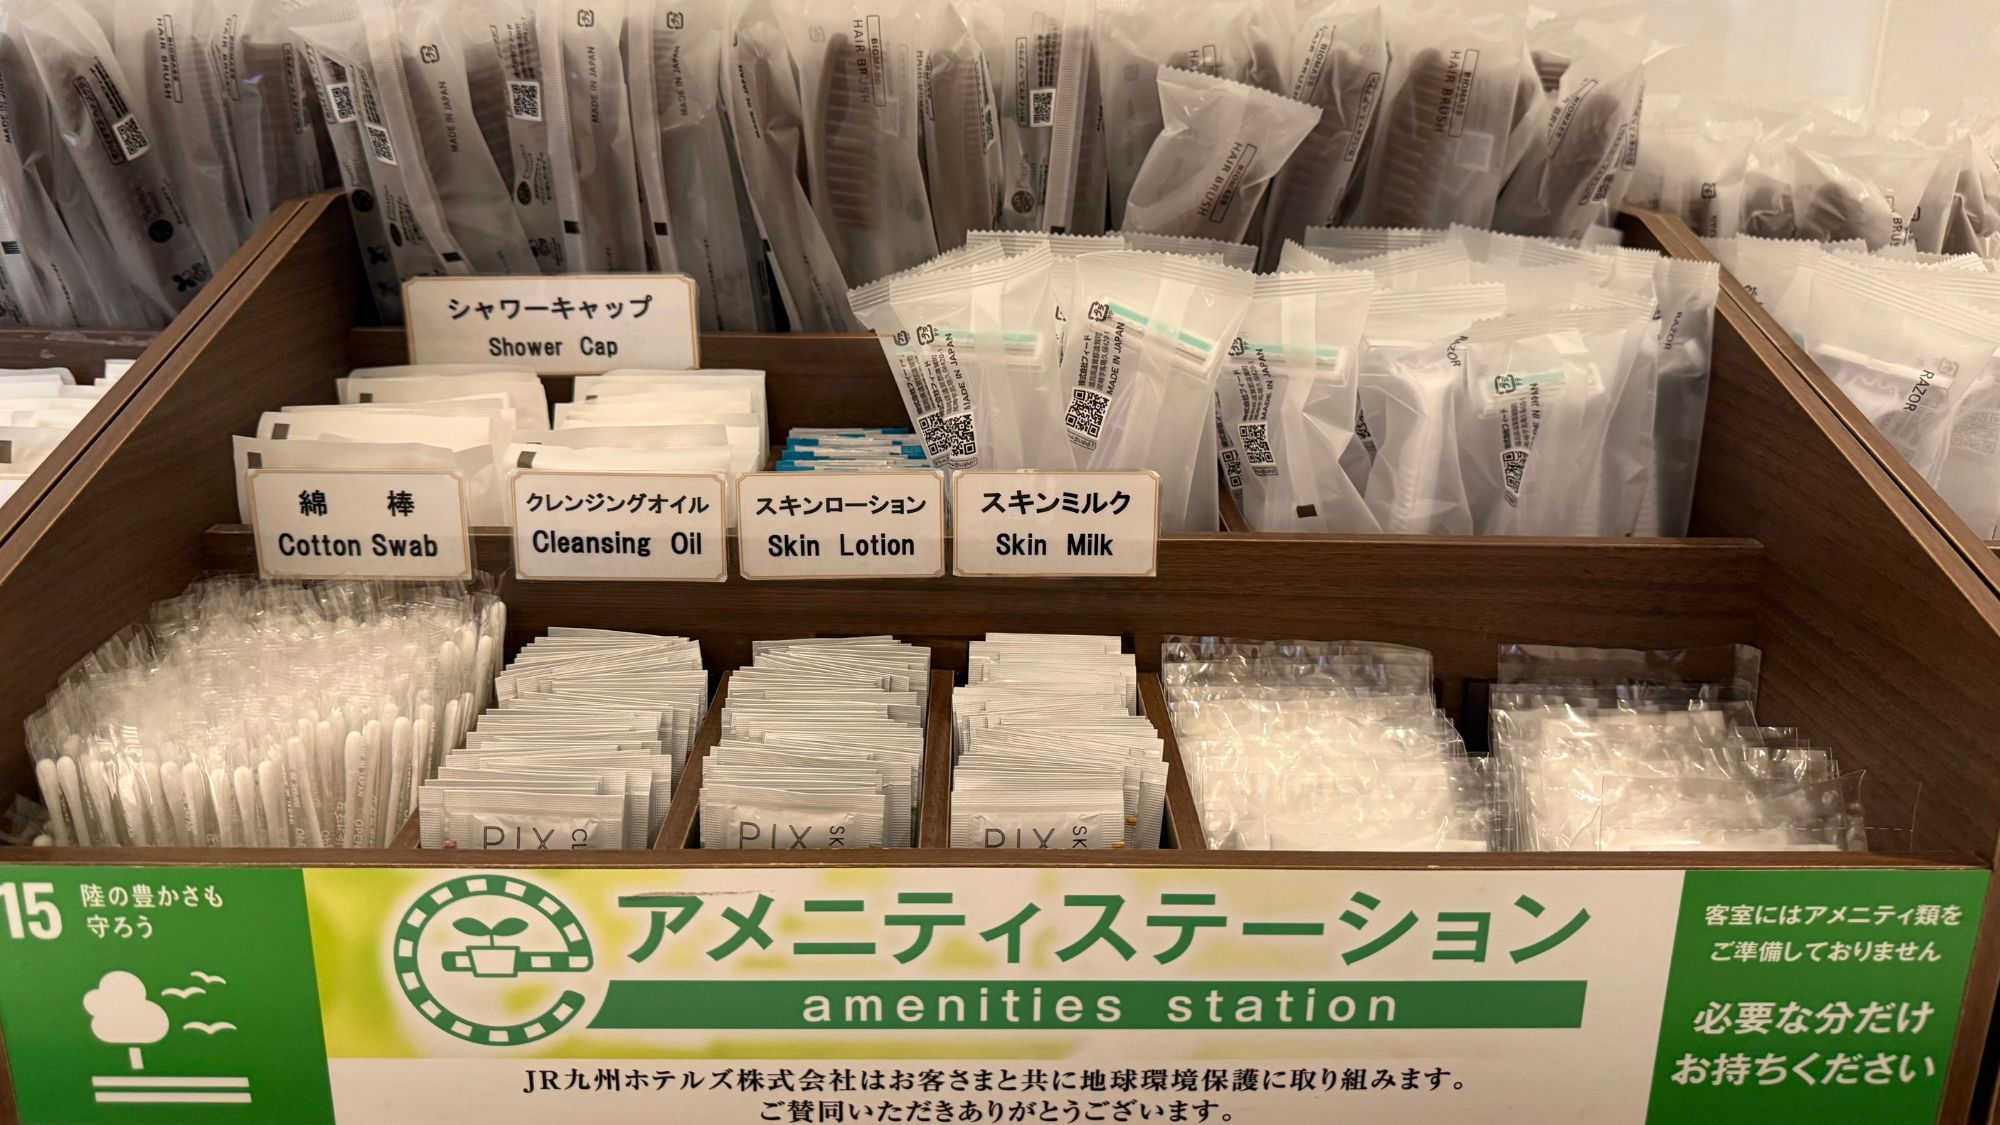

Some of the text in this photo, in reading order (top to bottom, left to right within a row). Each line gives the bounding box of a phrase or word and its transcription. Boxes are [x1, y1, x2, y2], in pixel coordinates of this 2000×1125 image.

[852, 18, 866, 53] HAIR
[587, 46, 600, 124] MADE IN JAPAN
[671, 45, 689, 117] MADE IN JAPAN
[1433, 50, 1461, 134] HAIR BRUSH
[438, 80, 458, 152] MADE IN JAPAN
[1198, 142, 1243, 218] HAIR BRUSH
[449, 295, 653, 319] シャワーキャップ
[1664, 311, 1683, 351] RAZOR
[489, 337, 618, 357] Shower Cap
[1078, 334, 1092, 386] 株式会社フィード
[1106, 321, 1126, 396] MADE IN JAPAN
[944, 332, 972, 411] MADE IN JAPAN
[1255, 348, 1274, 420] MADE IN JAPAN
[1903, 369, 1935, 412] RAZOR
[526, 492, 710, 514] クレンジングオイル
[756, 495, 927, 516] スキンローション
[981, 491, 1131, 515] スキンミルク
[278, 532, 438, 557] Cotton Swab
[532, 530, 702, 557] Cleansing Oil
[768, 534, 915, 557] Skin Lotion
[996, 533, 1113, 556] Skin Milk
[483, 826, 555, 849] PIX
[739, 821, 812, 849] PIX
[0, 882, 63, 940] 15
[80, 884, 224, 908] 陸の豊かさも
[87, 914, 154, 939] 守ろう
[618, 891, 1591, 966] アメニティステーション
[1705, 904, 1963, 926] 客室にはアメニティ類を
[1710, 941, 1942, 963] ご準備しておりません
[803, 987, 1397, 1023] amenities station
[1693, 1001, 1934, 1035] 必要な分だけ
[523, 1068, 1464, 1093] JR九州ホテルズ株式会社はお客さまと共に地球環境保護に取り組みます。
[1671, 1052, 1935, 1087] お持ちください
[760, 1099, 1233, 1124] ご賛同いただきありがとうございます。
